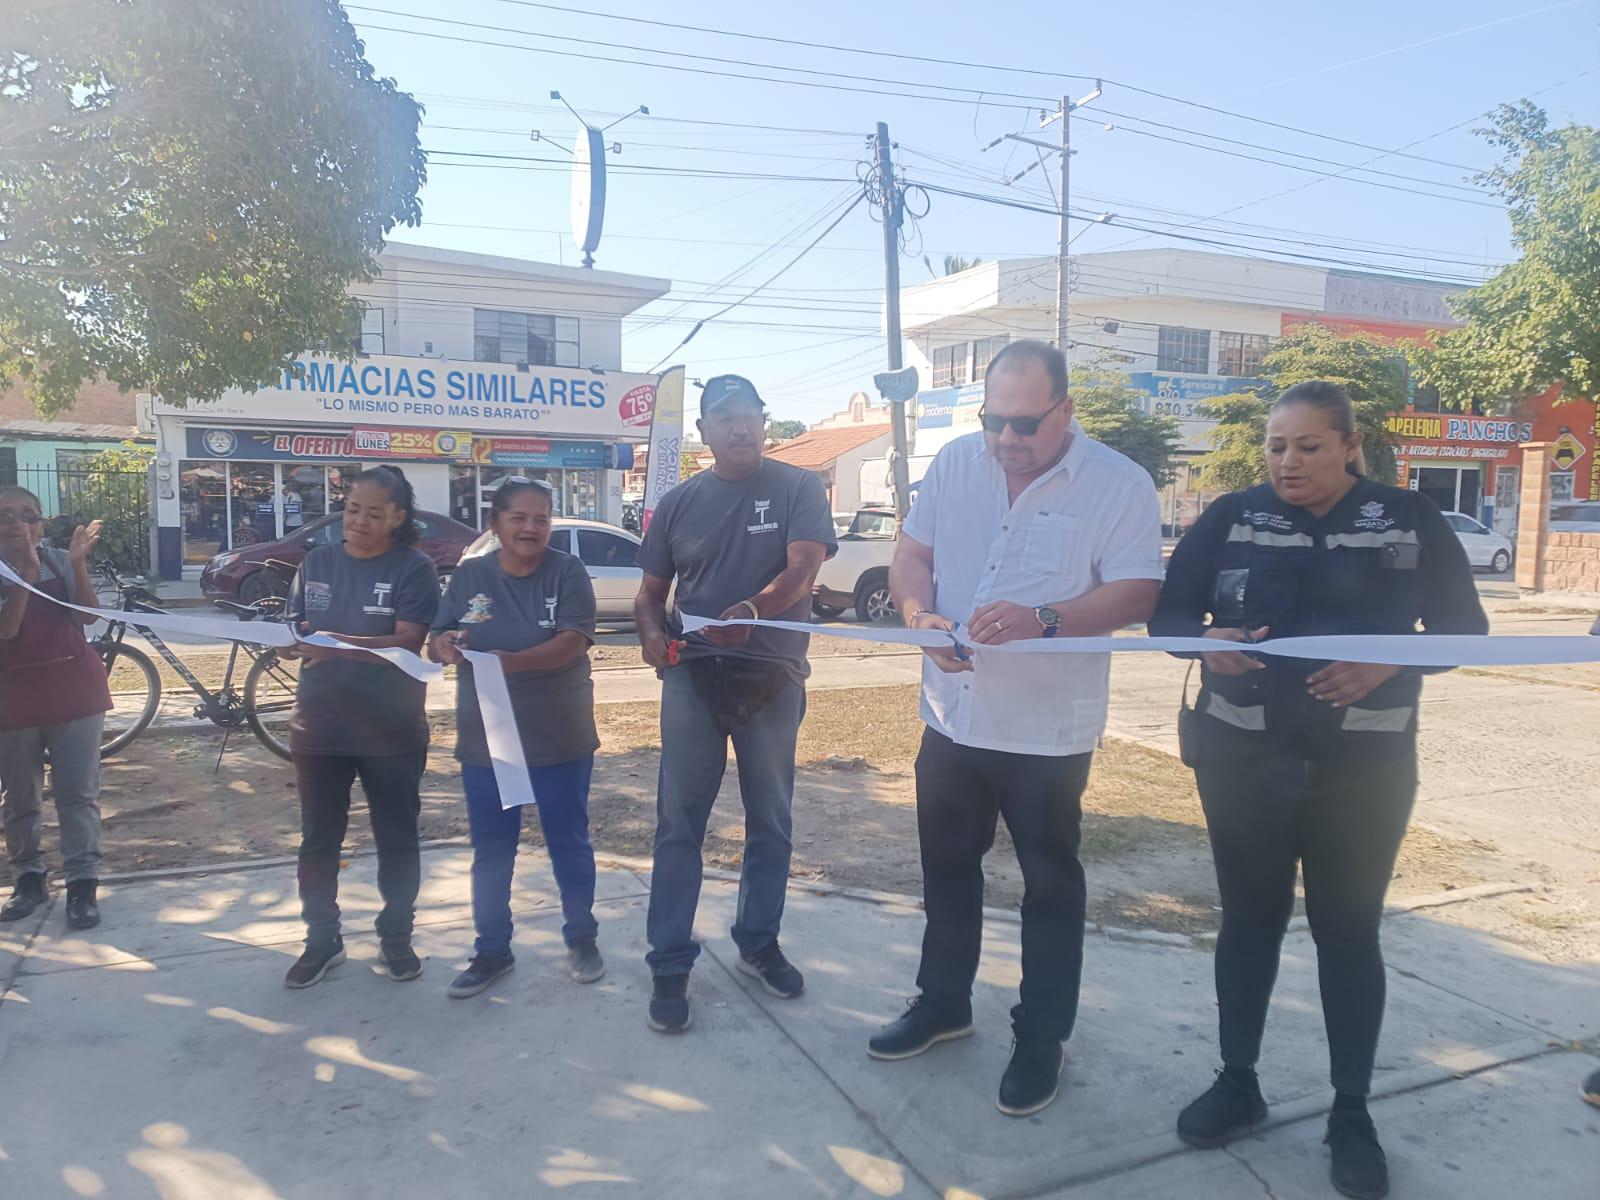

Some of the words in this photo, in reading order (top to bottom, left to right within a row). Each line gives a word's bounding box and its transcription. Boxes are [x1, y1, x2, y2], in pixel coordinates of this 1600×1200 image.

[259, 361, 436, 399] RMACIAS
[447, 371, 606, 408] SIMILARES
[349, 400, 399, 413] MISMO
[404, 402, 444, 416] PERO
[391, 432, 432, 448] 25%
[1447, 418, 1533, 443] PANCHOS
[274, 435, 290, 451] EL
[357, 438, 389, 450] LUNES
[654, 438, 669, 502] CONSULTA
[666, 438, 678, 492] EDICA
